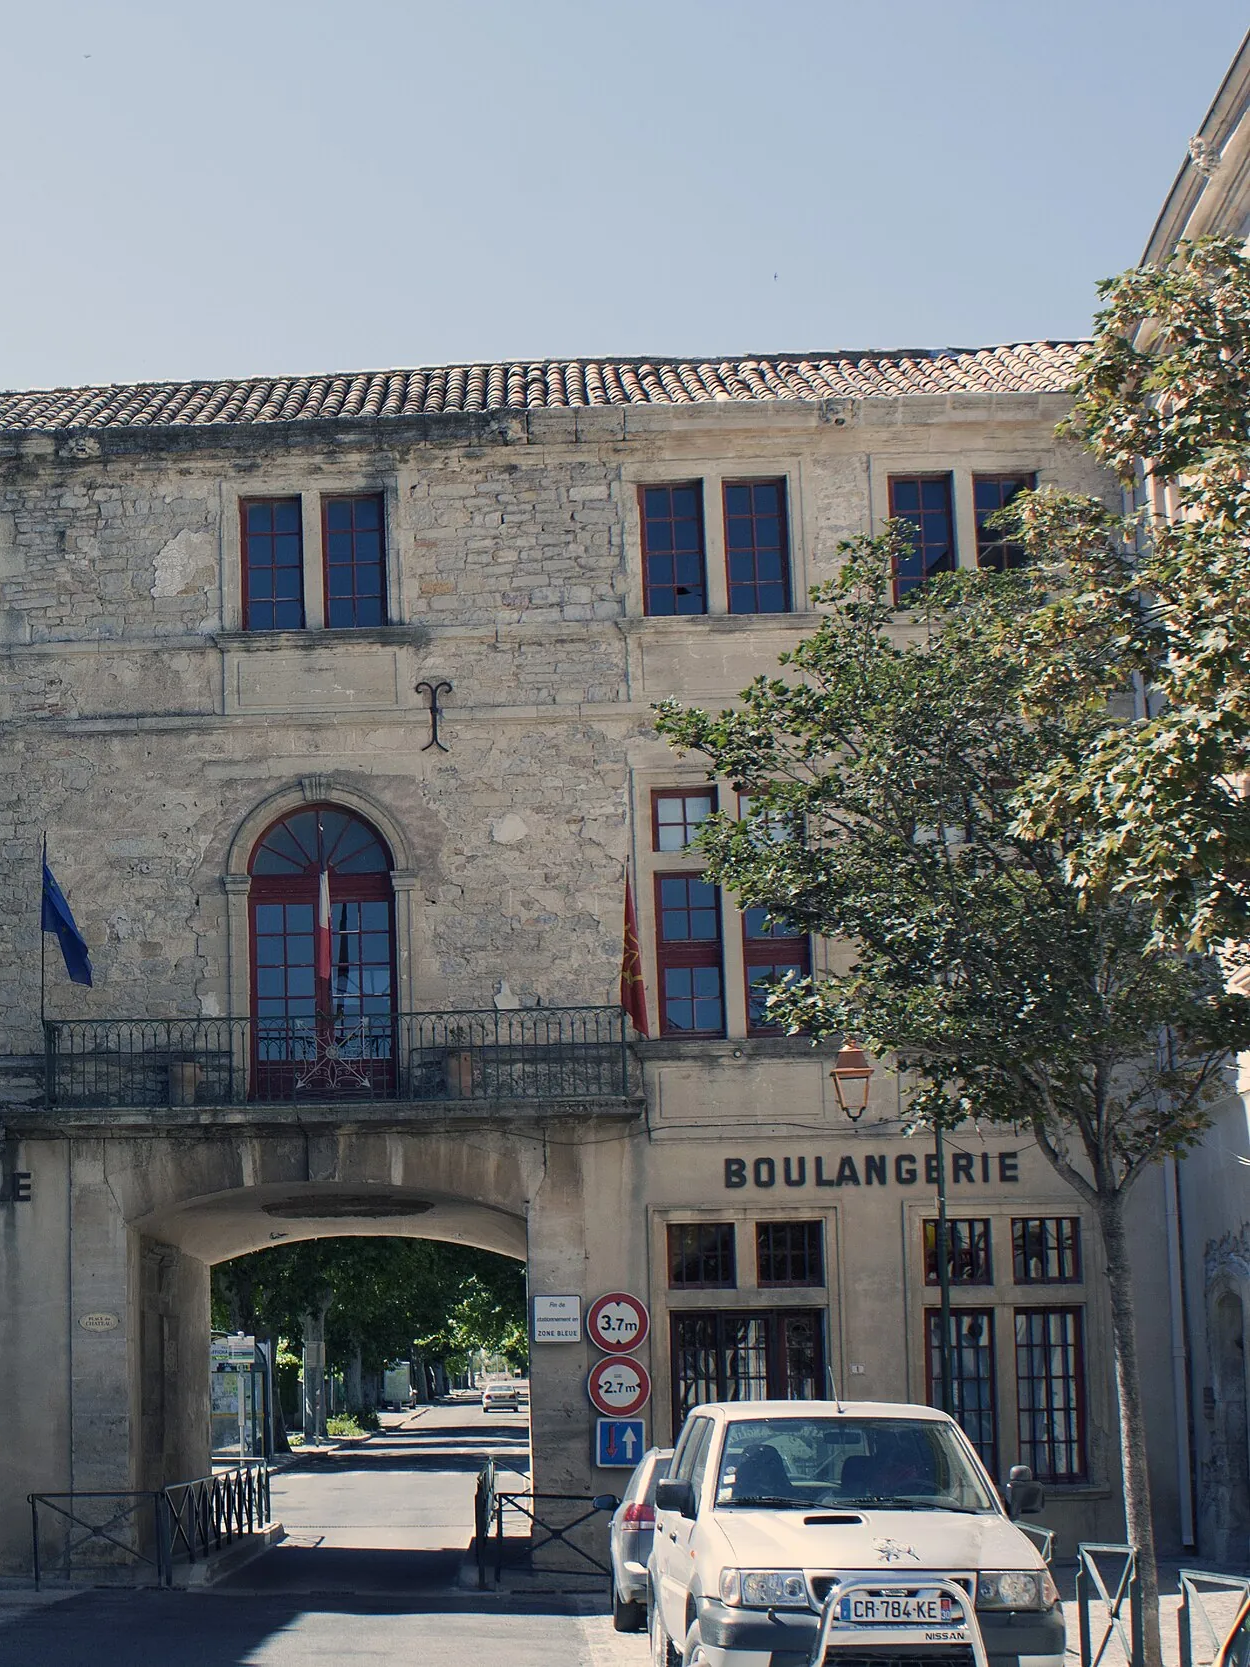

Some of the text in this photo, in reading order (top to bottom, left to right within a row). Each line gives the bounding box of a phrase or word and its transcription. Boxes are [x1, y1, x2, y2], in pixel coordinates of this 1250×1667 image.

[724, 1151, 1019, 1189] BOULANGERIE
[854, 1600, 937, 1618] CR-784-KE
[941, 1610, 950, 1620] 30
[925, 1632, 965, 1641] NISSAN
